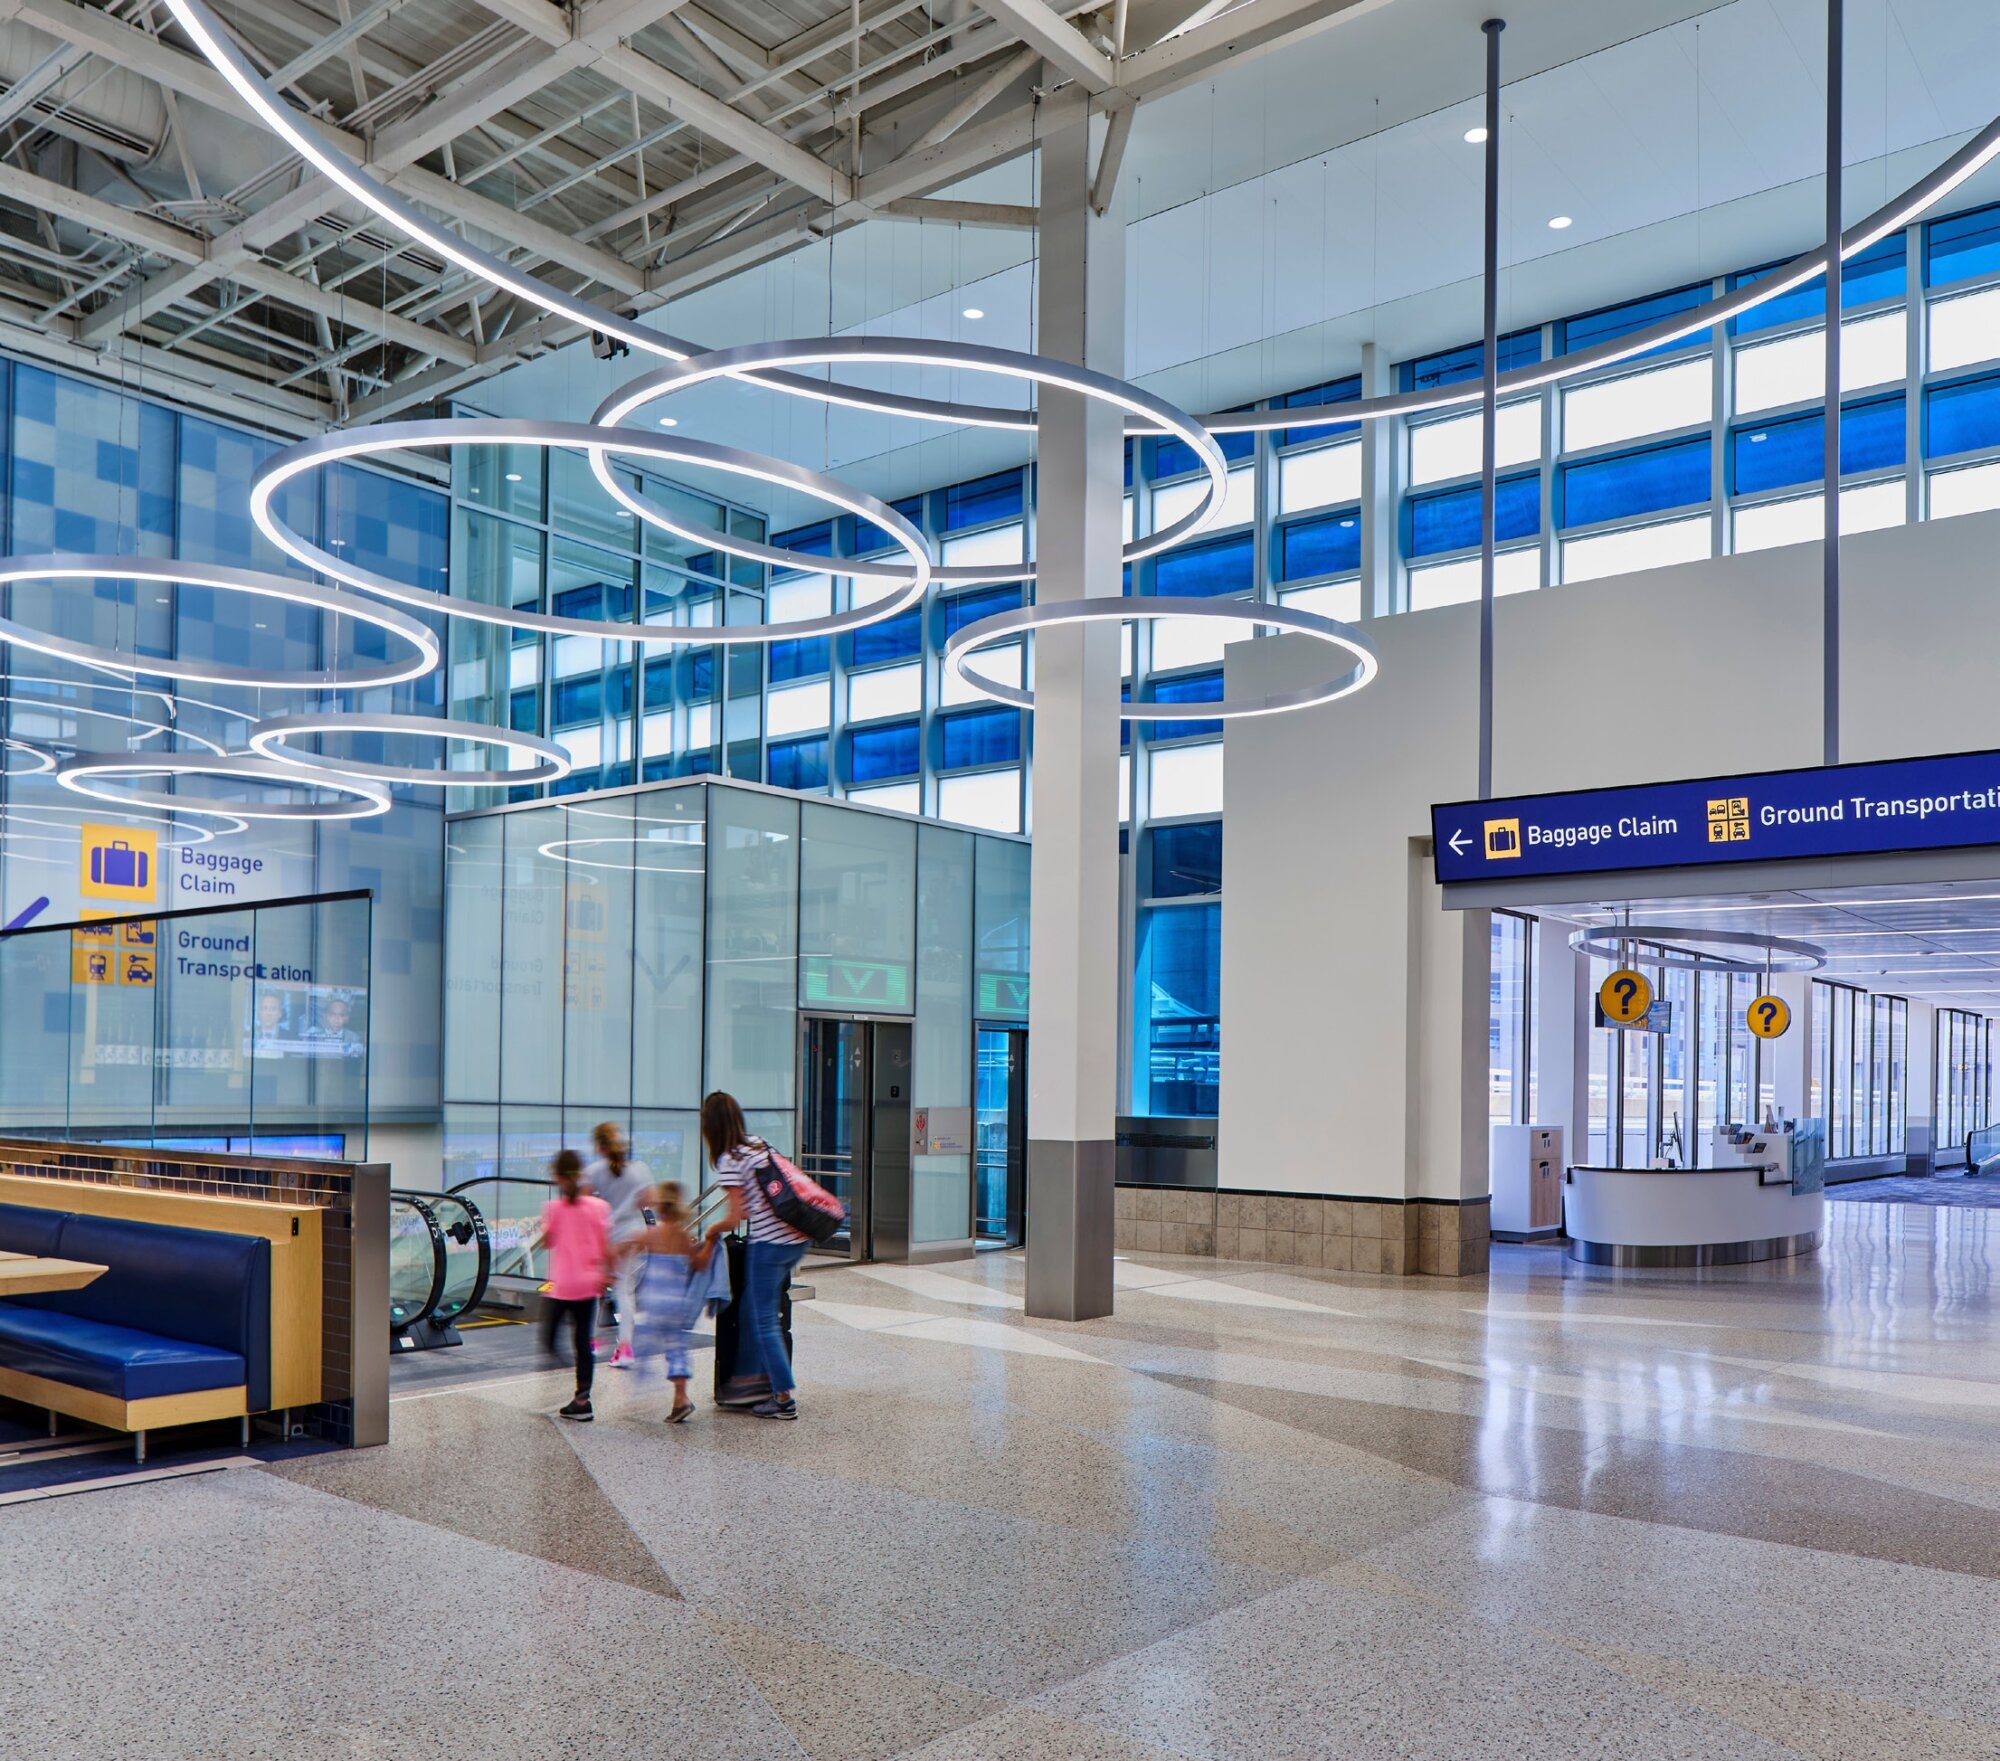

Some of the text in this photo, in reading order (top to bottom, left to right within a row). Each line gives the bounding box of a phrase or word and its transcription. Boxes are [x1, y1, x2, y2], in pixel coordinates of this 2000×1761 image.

[1760, 800, 1844, 826] Ground
[1528, 815, 1678, 848] Baggage Claim
[181, 847, 264, 874] Baggage
[180, 873, 235, 894] Claim
[178, 930, 250, 952] Ground
